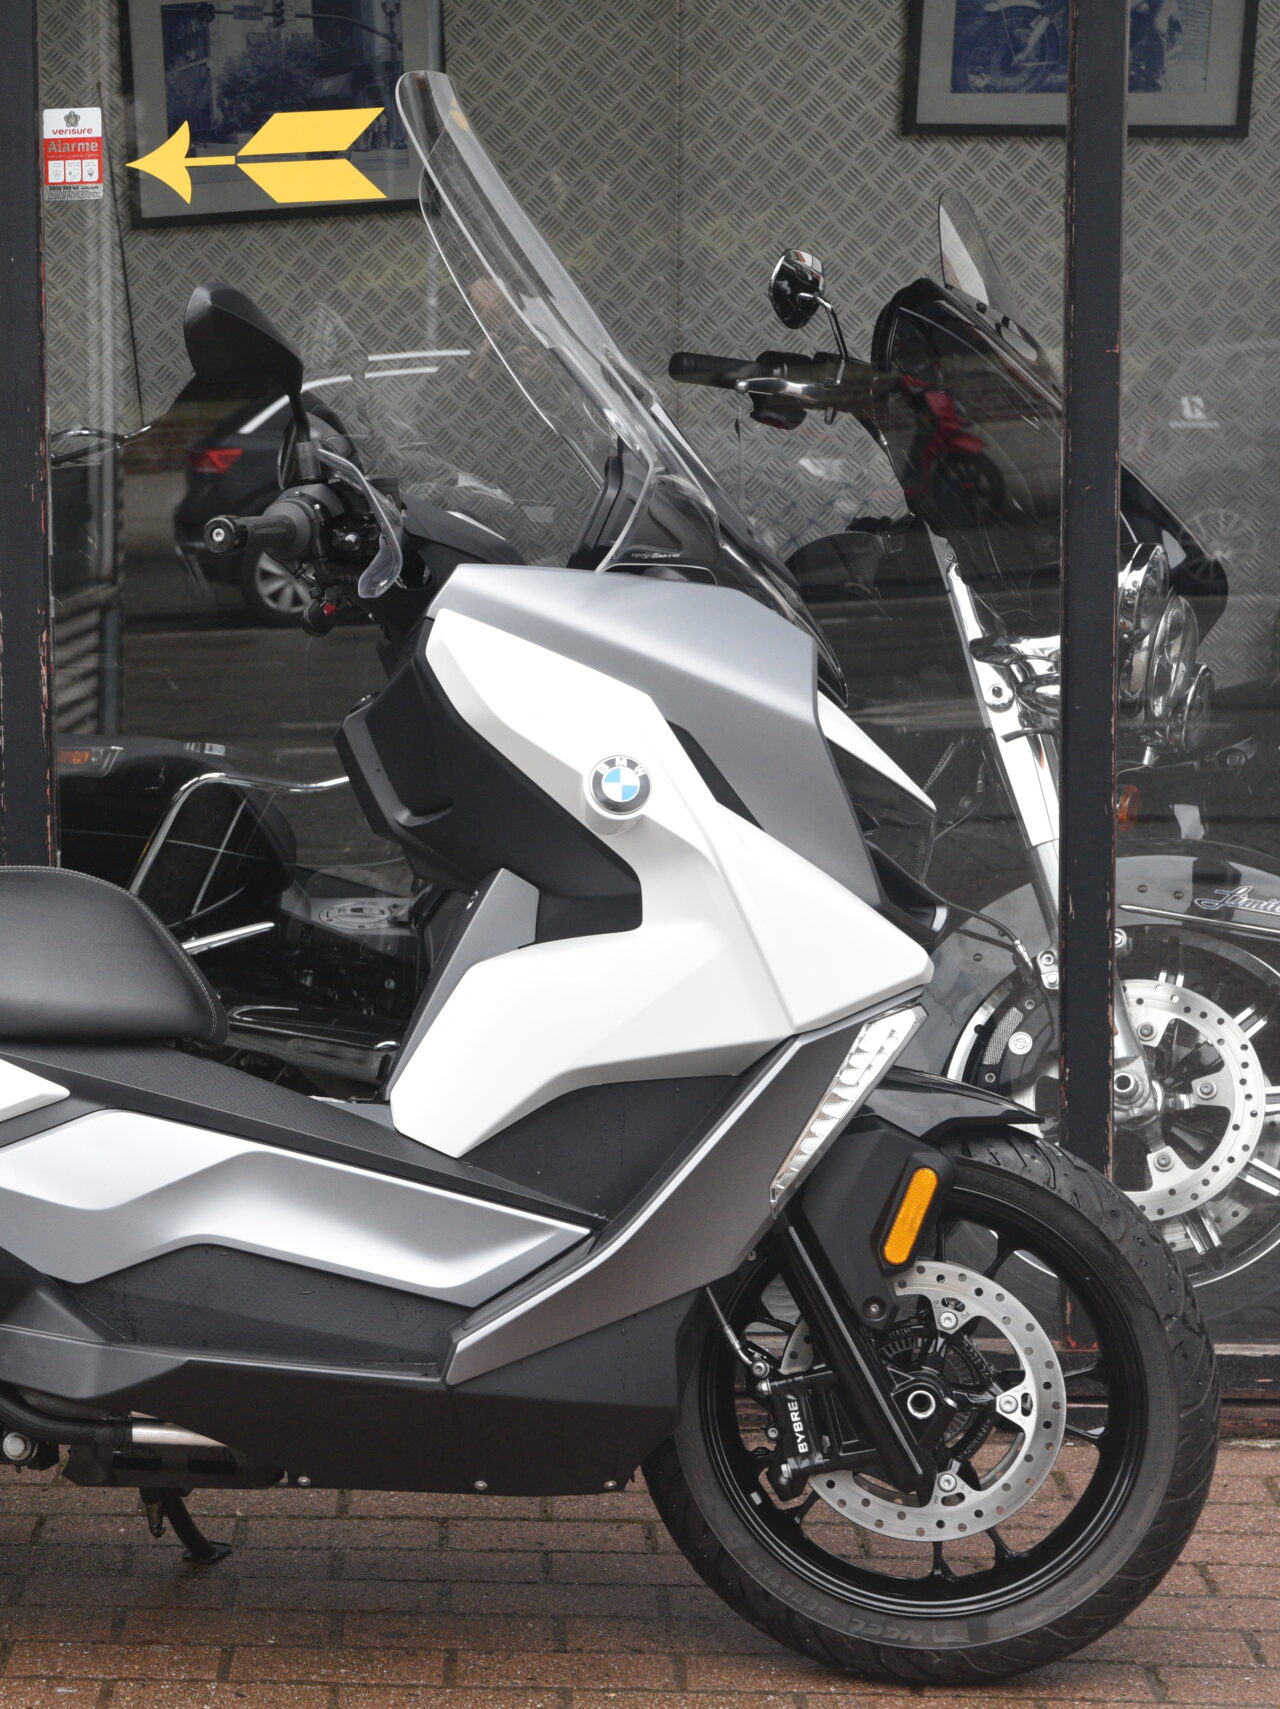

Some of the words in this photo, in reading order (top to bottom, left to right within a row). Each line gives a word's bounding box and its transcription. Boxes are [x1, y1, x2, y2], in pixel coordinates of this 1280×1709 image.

[52, 127, 93, 136] verisure
[48, 140, 99, 153] Alarme
[787, 1401, 809, 1454] BYBRE
